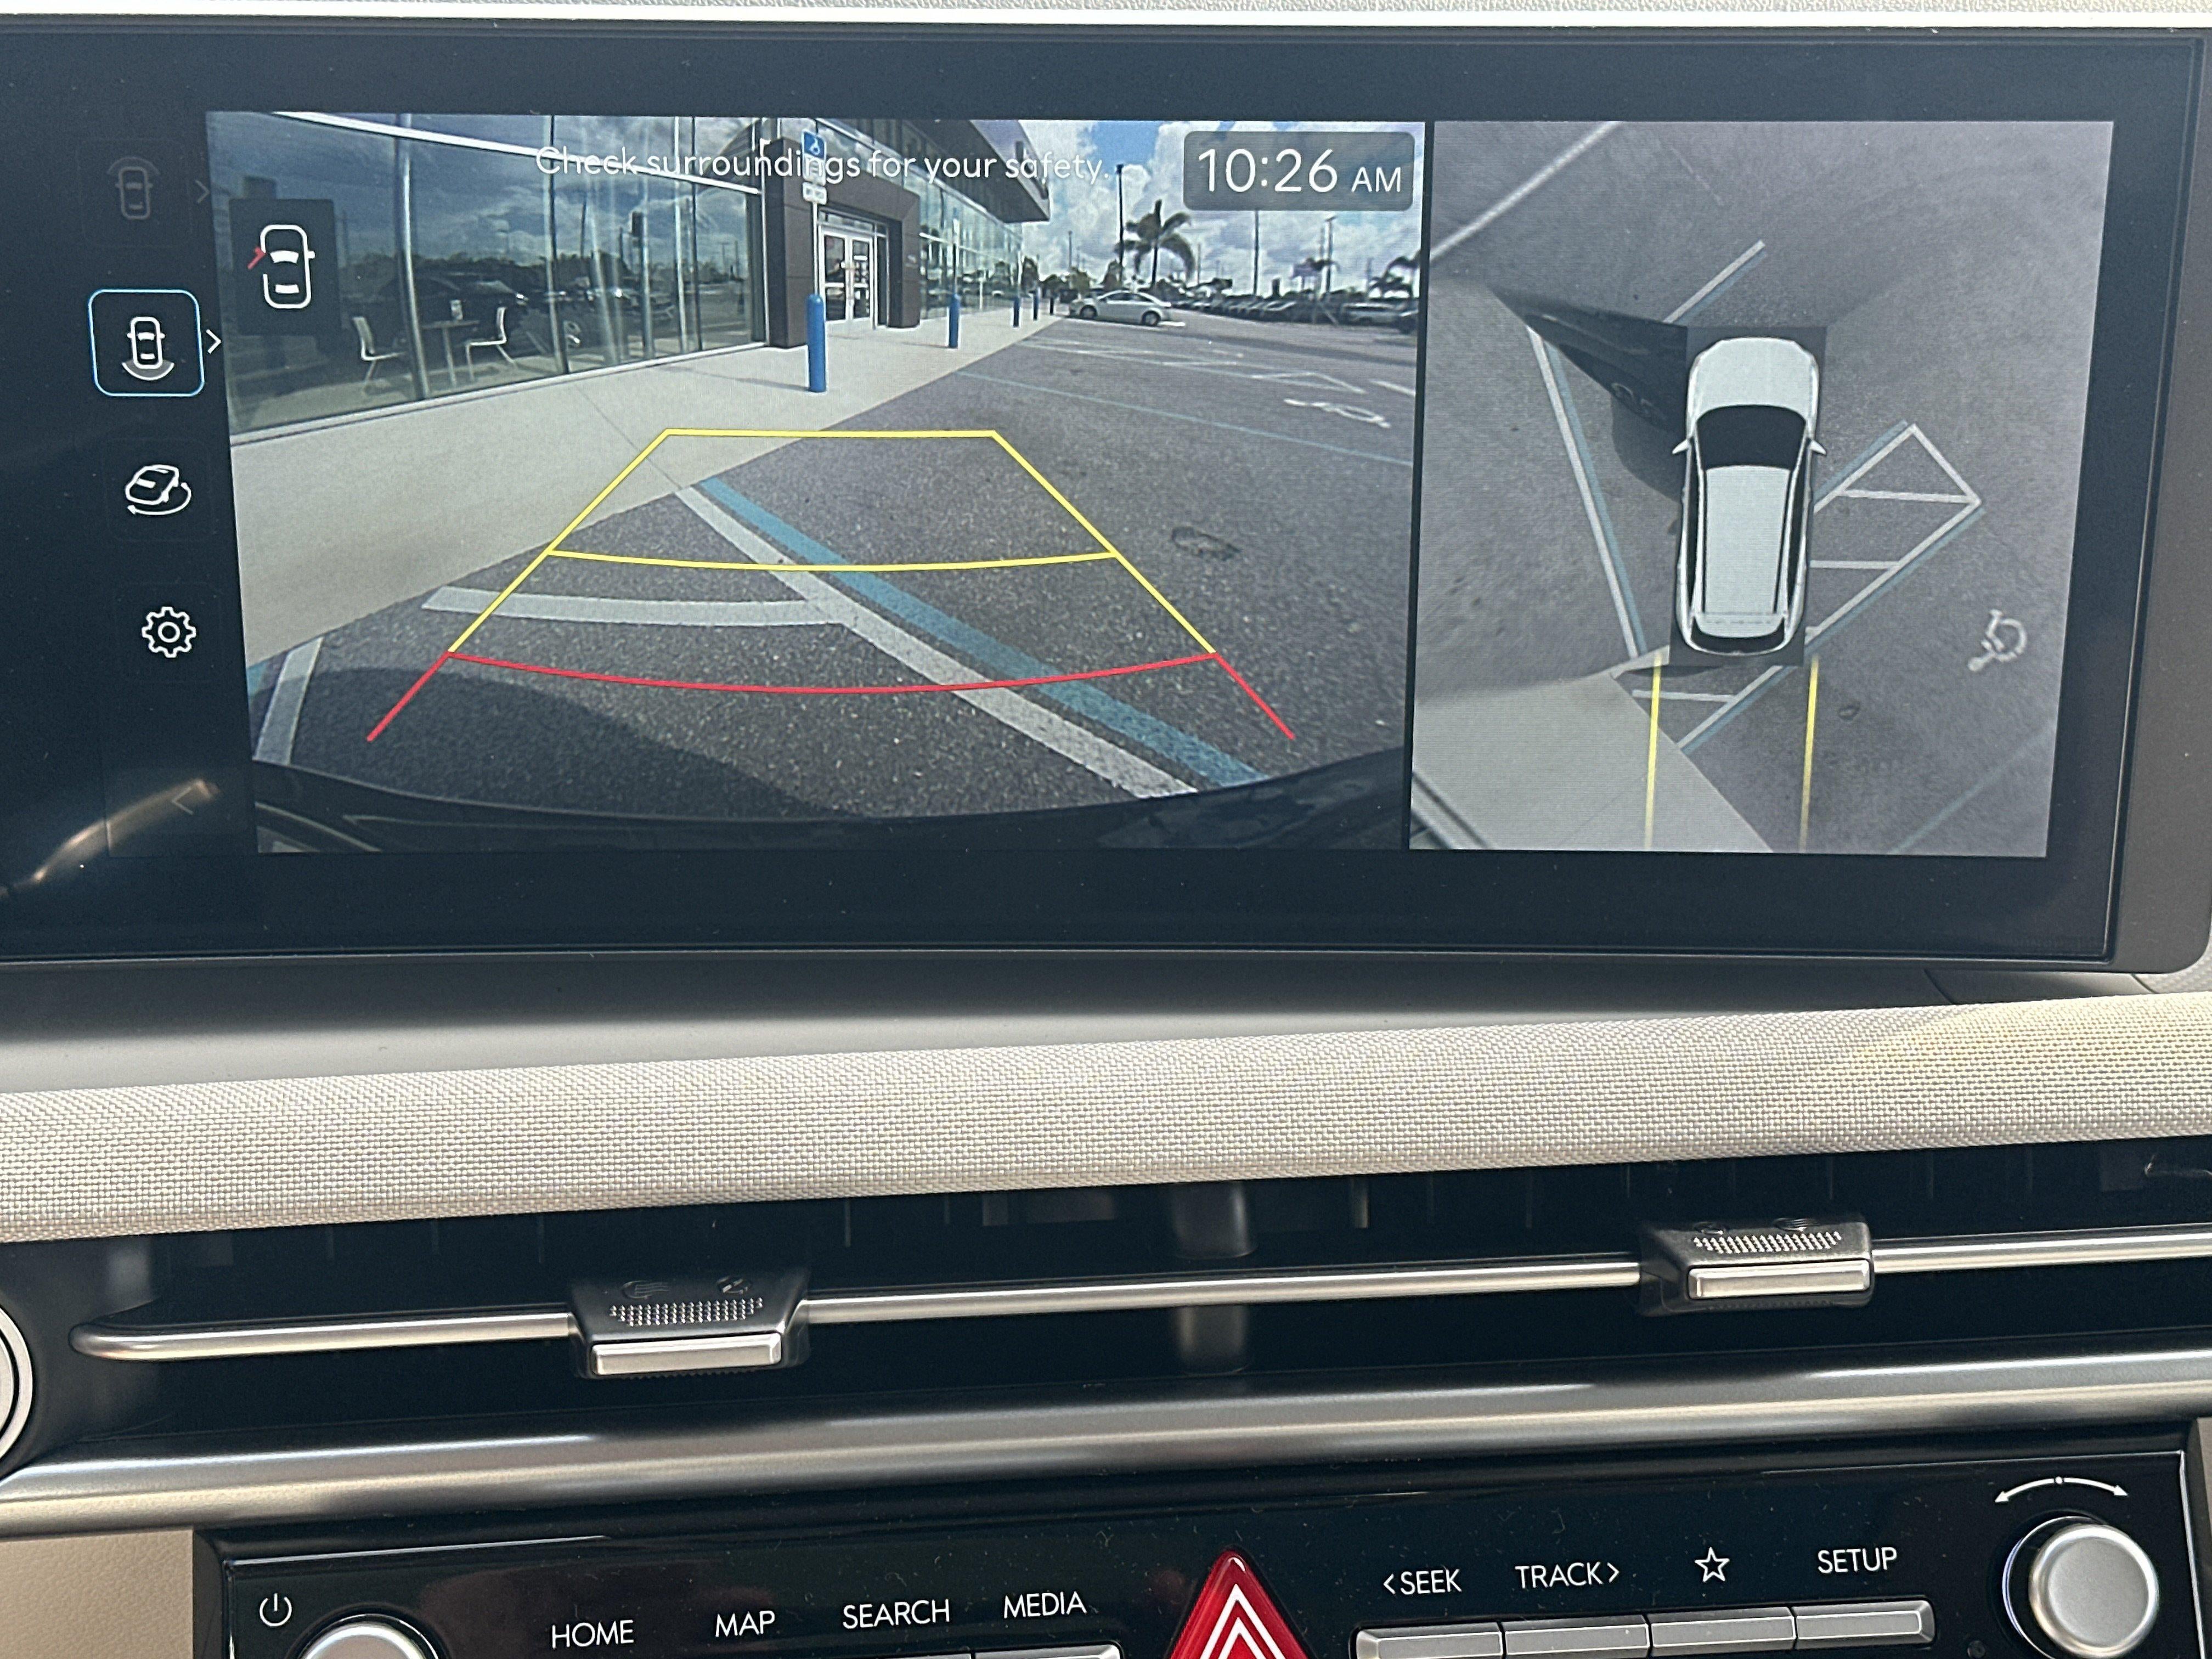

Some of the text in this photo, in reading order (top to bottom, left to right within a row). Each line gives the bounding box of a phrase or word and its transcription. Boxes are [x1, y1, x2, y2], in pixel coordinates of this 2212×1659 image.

[535, 145, 637, 176] Check
[647, 146, 860, 184] surroundings
[869, 150, 917, 178] for
[924, 156, 997, 185] your
[1005, 151, 1109, 185] safety.
[1199, 149, 1402, 193] 10:26 AM
[1817, 1547, 1898, 1575] SETUP
[843, 1599, 950, 1629] SEARCH
[1003, 1592, 1087, 1619] MEDIA
[551, 1620, 634, 1648] HOME
[714, 1610, 775, 1638] MAP
